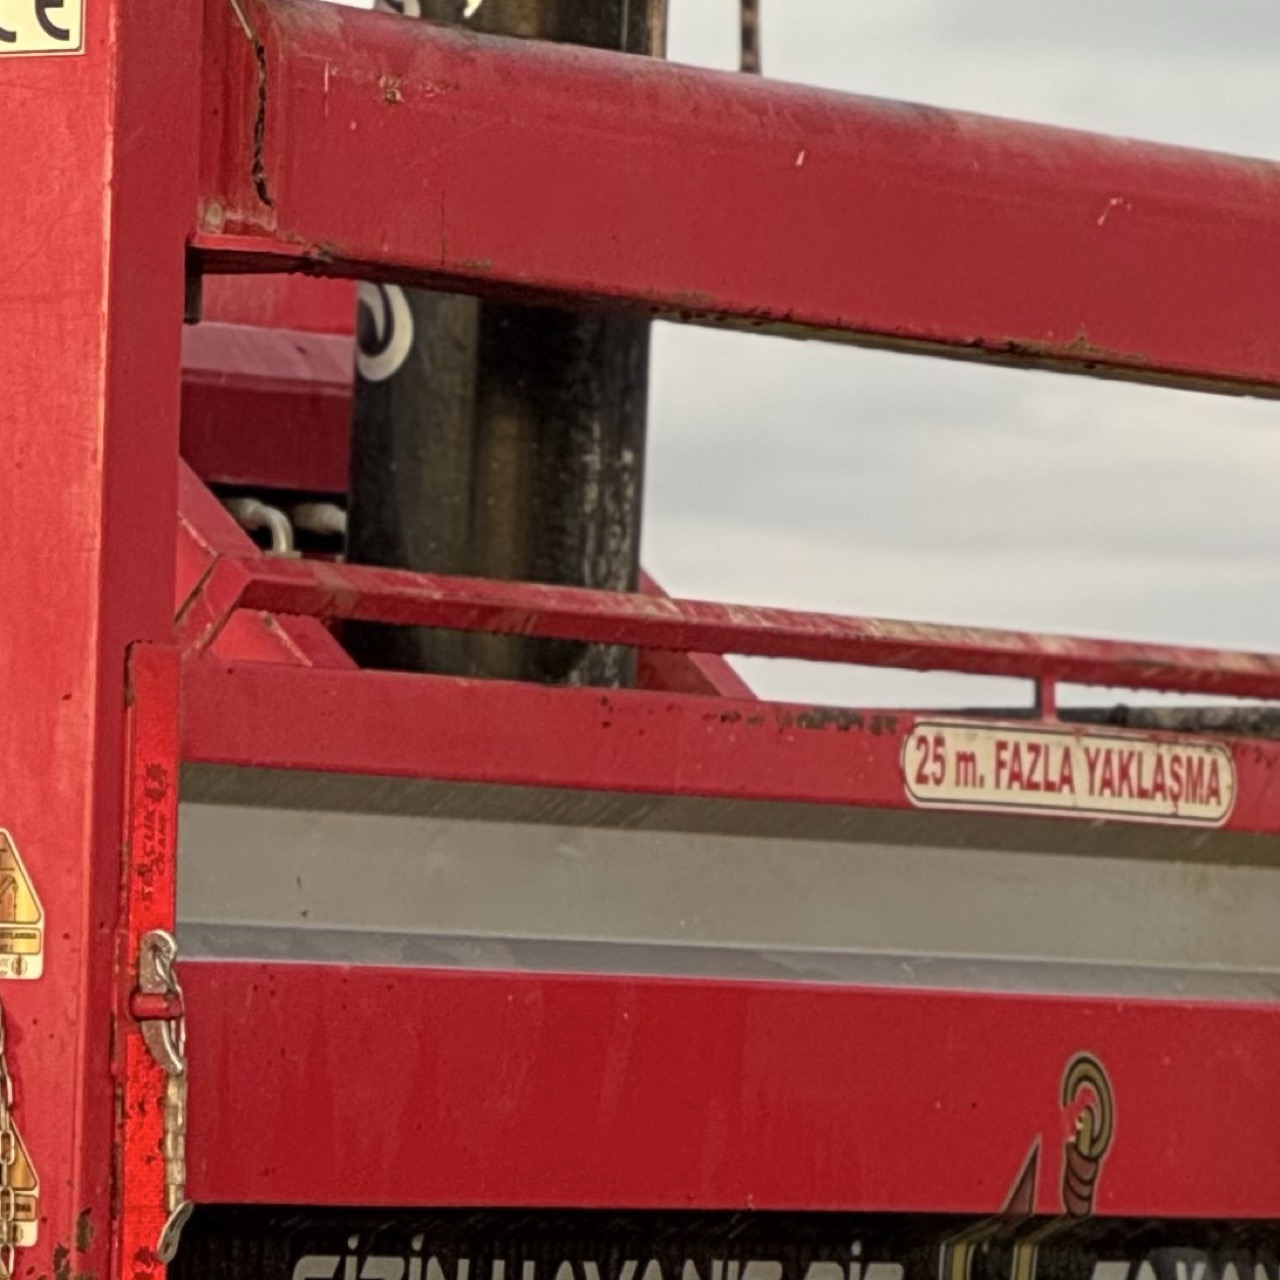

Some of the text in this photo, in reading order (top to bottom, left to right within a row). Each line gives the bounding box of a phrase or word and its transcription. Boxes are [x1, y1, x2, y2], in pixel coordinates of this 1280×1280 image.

[914, 734, 1223, 807] 25 m. FAZLA YAKLAŞMA
